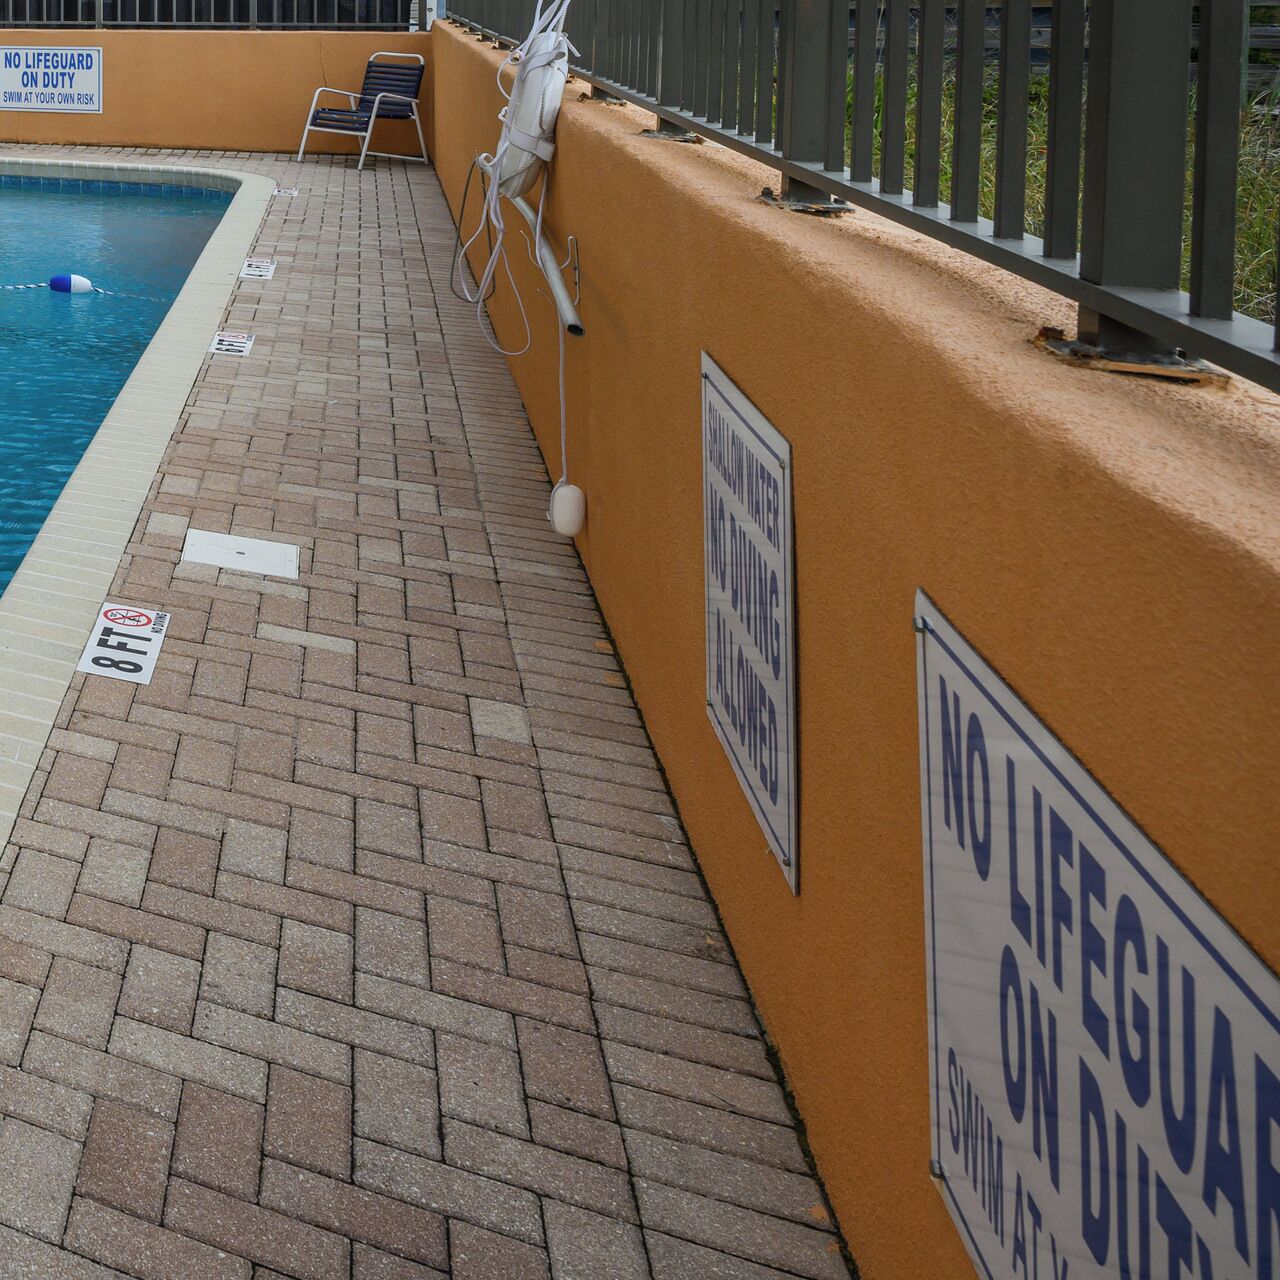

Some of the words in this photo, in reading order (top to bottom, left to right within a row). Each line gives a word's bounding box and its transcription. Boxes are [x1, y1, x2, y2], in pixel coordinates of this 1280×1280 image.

[3, 91, 22, 103] SWIM
[24, 92, 33, 103] AT
[35, 92, 55, 104] YOUR
[57, 93, 75, 104] OWN
[77, 93, 95, 105] RISK
[4, 52, 21, 69] NO
[25, 52, 93, 70] LIFEGUARD
[21, 71, 38, 88] ON
[43, 72, 75, 89] DUTY
[709, 399, 744, 506] SHALLOW
[746, 446, 780, 554] WATER
[96, 626, 152, 656] FT
[710, 481, 726, 593] NO
[730, 511, 780, 681] DIVING
[91, 656, 143, 673] 8
[716, 607, 778, 807] ALLOWED
[940, 674, 992, 882] NO
[1000, 944, 1060, 1195] ON
[948, 1046, 1005, 1249] SWIM
